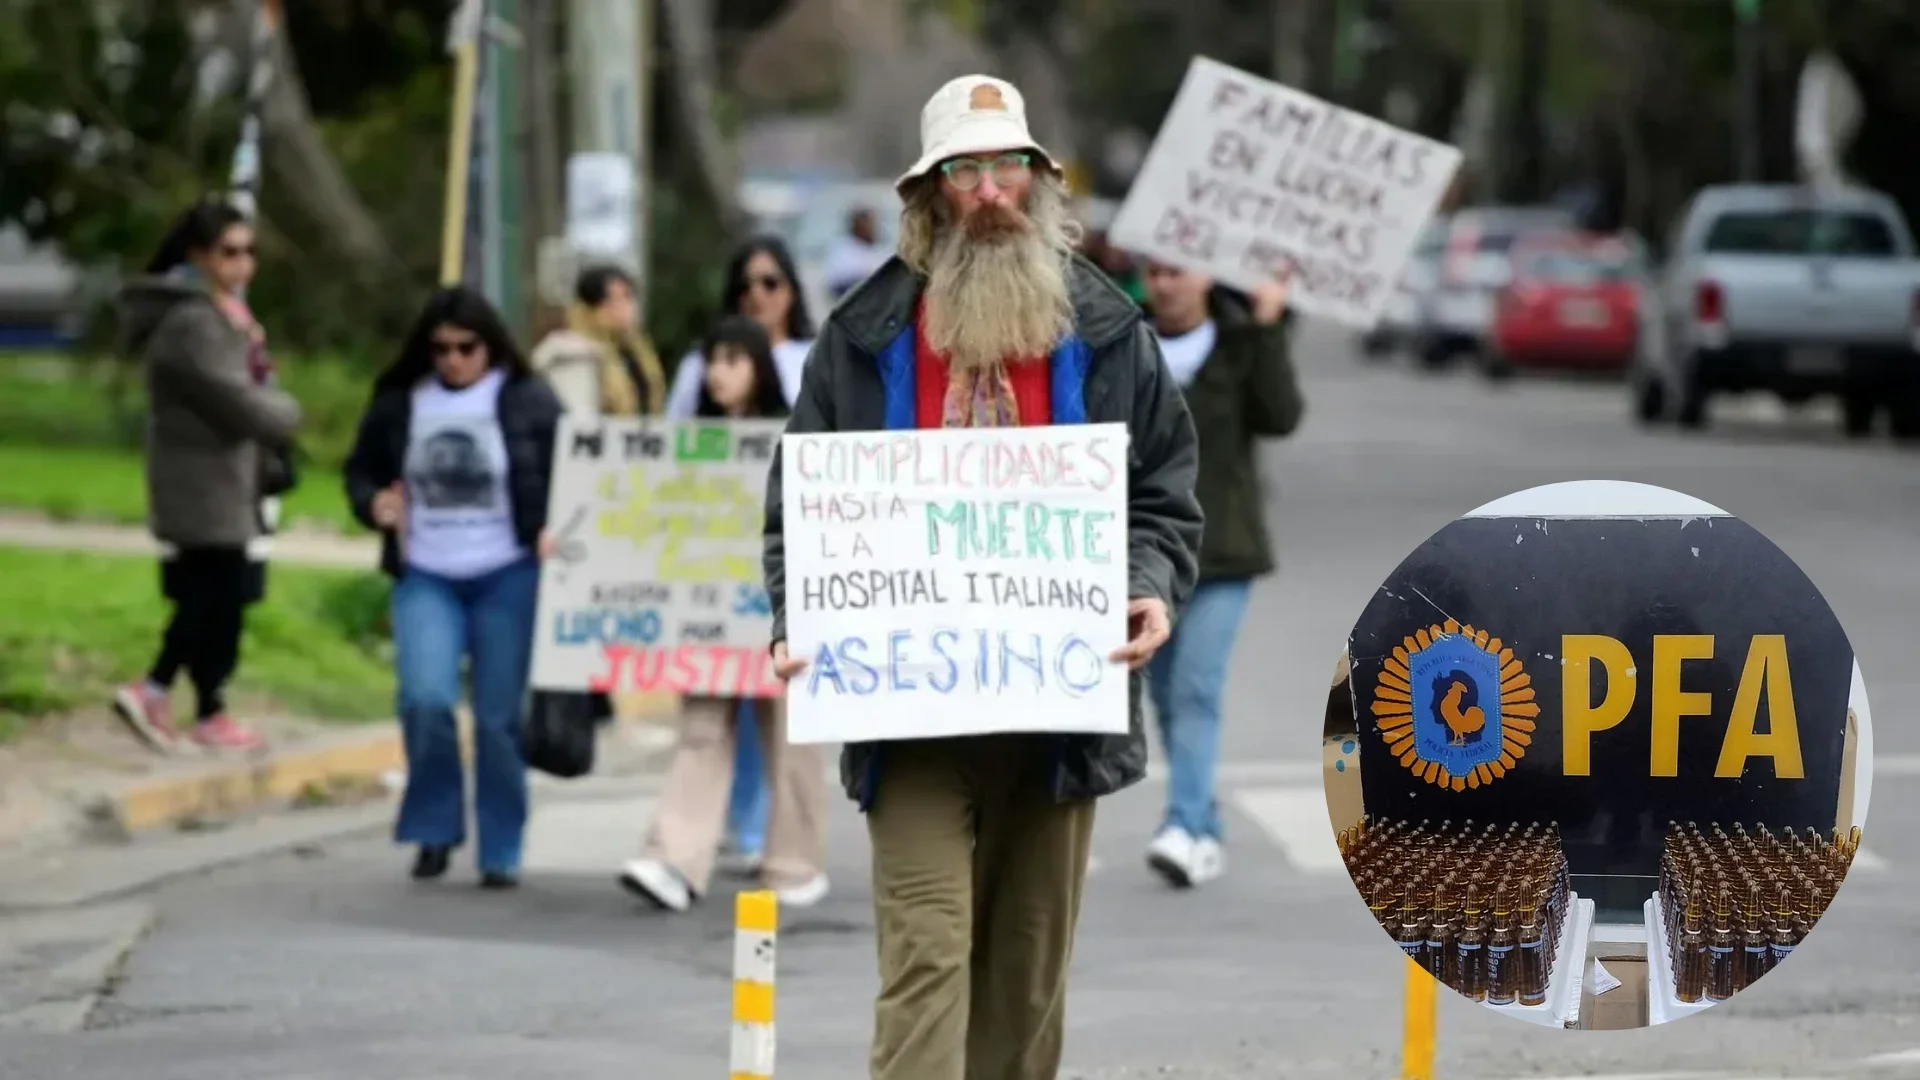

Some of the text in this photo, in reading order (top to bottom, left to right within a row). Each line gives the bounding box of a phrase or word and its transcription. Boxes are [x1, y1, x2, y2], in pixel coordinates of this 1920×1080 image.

[1209, 130, 1385, 209] EN LUCHA
[797, 437, 1116, 491] COMPLICIDADES
[800, 492, 907, 522] HASTA
[925, 501, 1115, 563] MUERTE
[821, 532, 873, 558] LA
[803, 569, 1108, 616] HOSPITAL ITALIANO
[808, 627, 1102, 699] ASESINO
[1562, 634, 1805, 779] PFA
